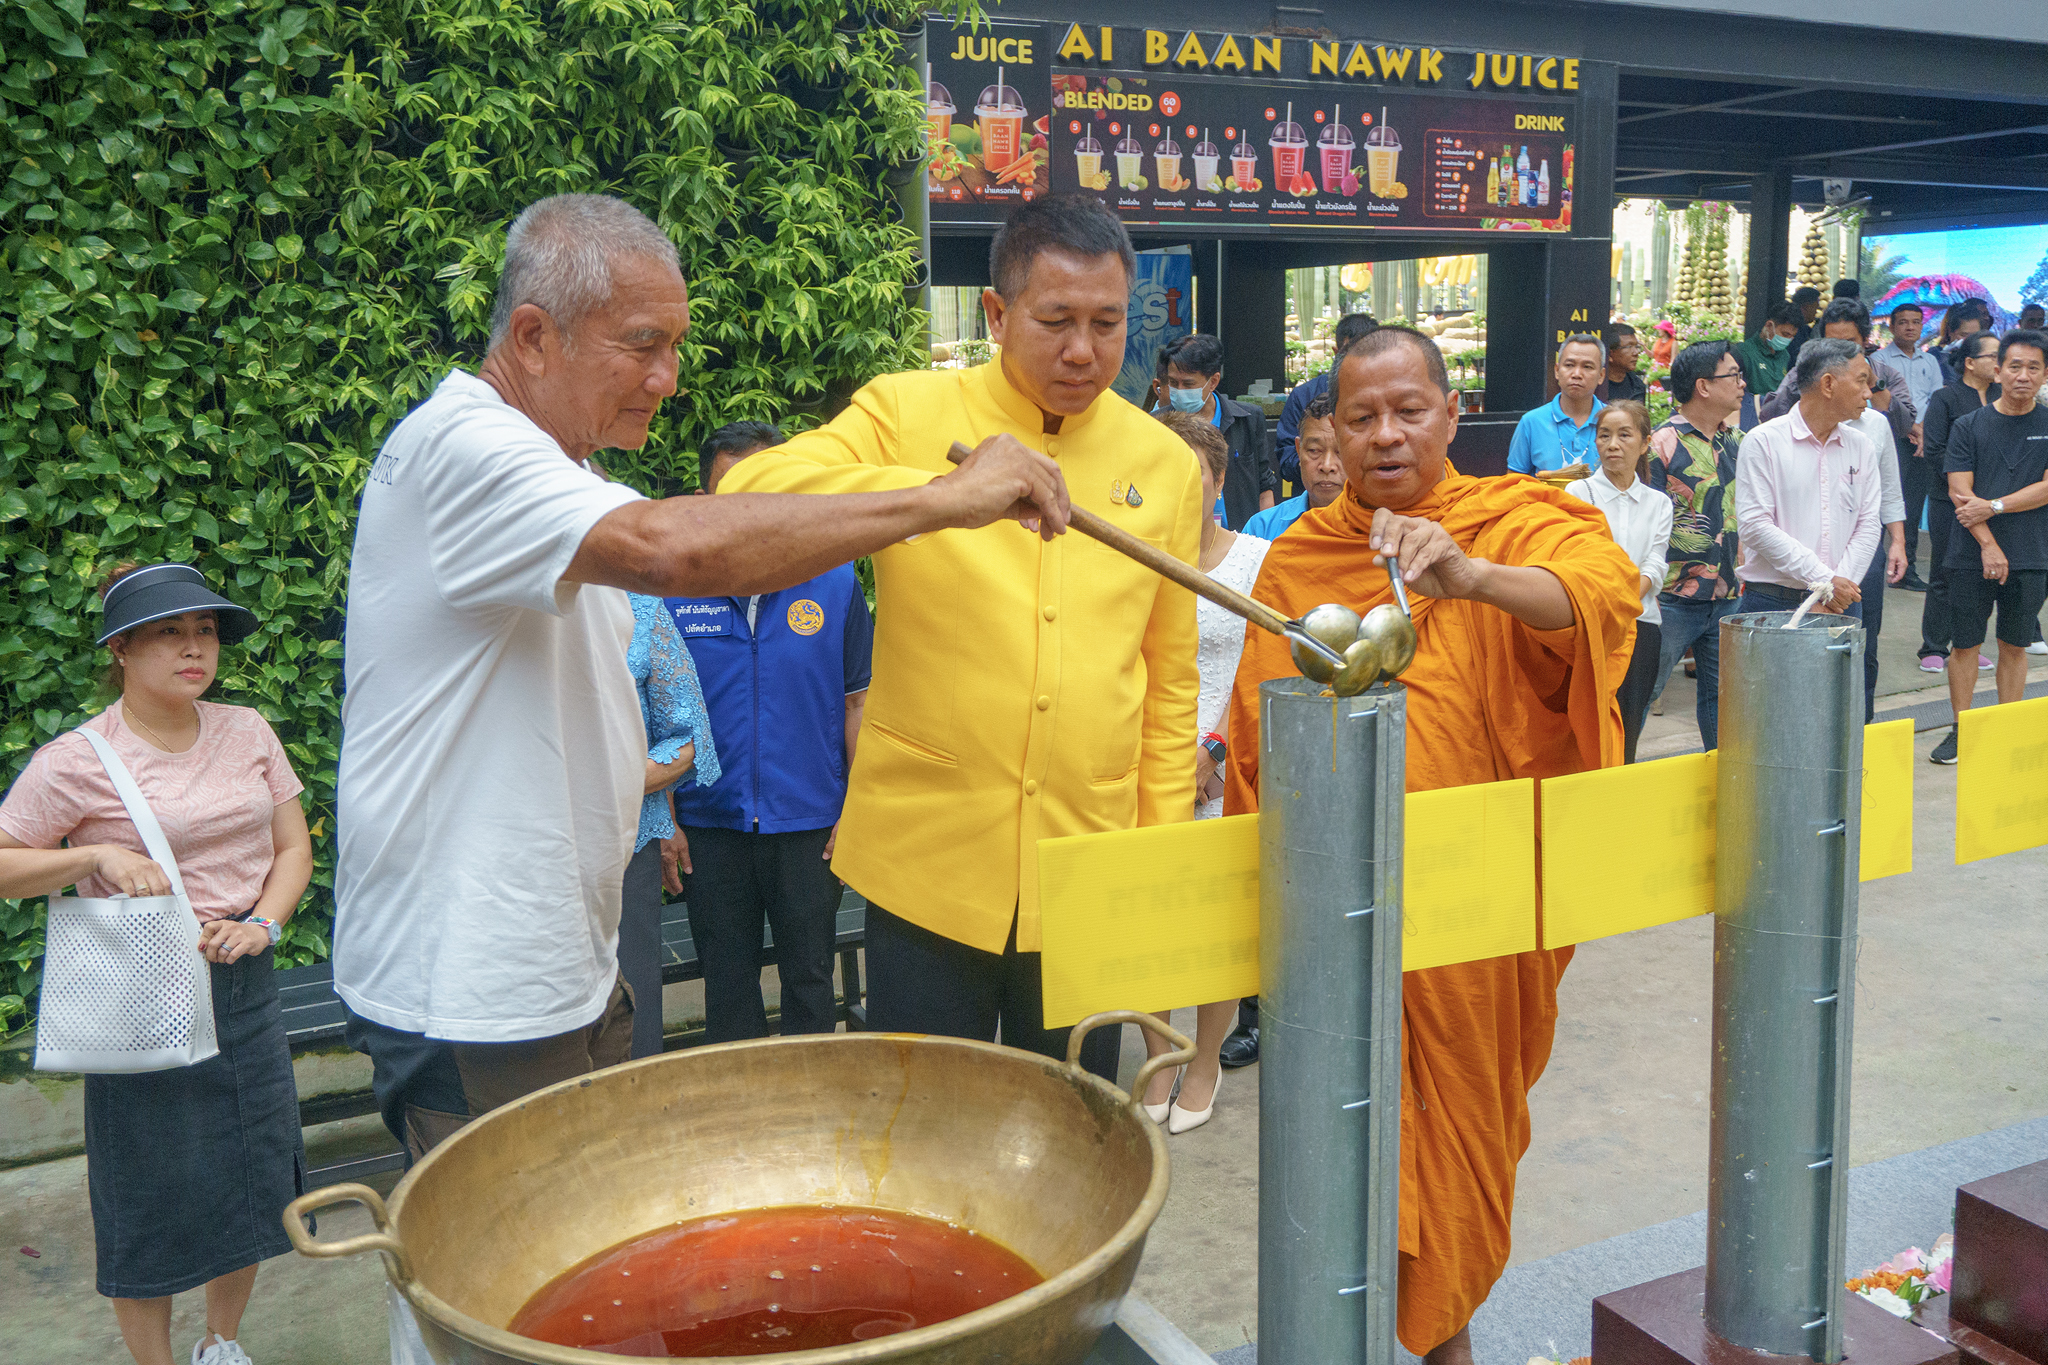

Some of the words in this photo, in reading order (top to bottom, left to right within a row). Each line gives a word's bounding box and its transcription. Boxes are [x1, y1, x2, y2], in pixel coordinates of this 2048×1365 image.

[950, 35, 1034, 64] JUICE
[1058, 22, 1113, 61] AI
[1145, 29, 1282, 72] BAAN
[1311, 39, 1444, 81] NAWK
[1470, 52, 1579, 90] JUICE
[1063, 91, 1153, 111] BLENDED
[1163, 97, 1176, 106] 60
[1514, 113, 1565, 132] DRINK
[1570, 308, 1588, 322] AI
[1556, 329, 1602, 343] BN
[684, 623, 722, 633] ปลัดอำเภอ
